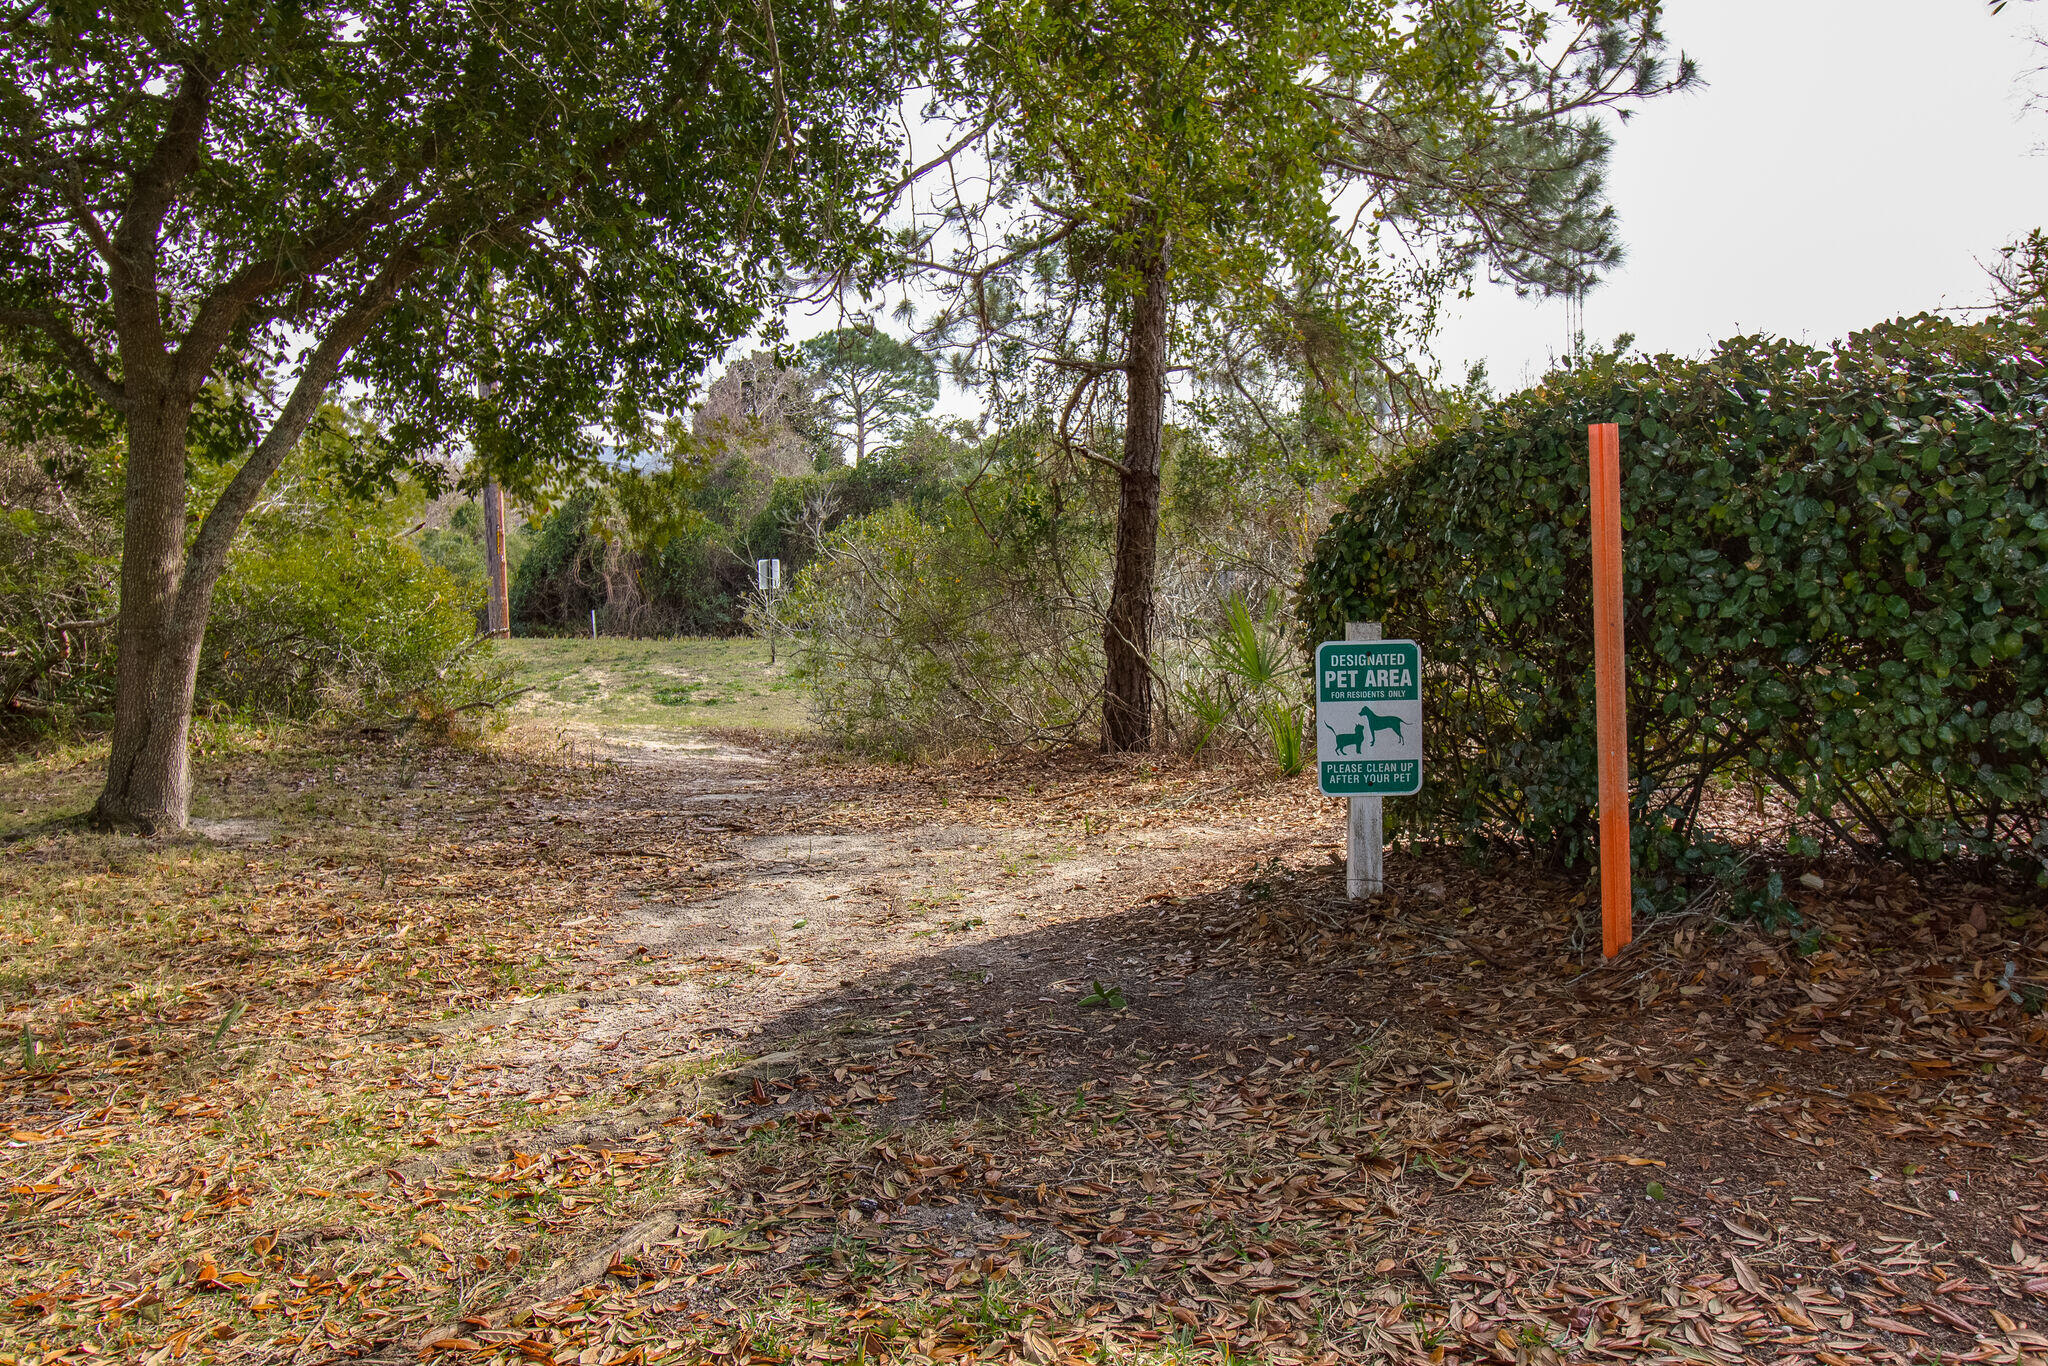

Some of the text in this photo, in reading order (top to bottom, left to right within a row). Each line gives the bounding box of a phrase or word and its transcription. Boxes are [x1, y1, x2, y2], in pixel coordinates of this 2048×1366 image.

[1331, 653, 1405, 667] DESIGNATED
[1324, 669, 1412, 688] PET AREA
[1331, 690, 1406, 699] FOR RESIDENTS ONLY
[1327, 762, 1414, 773] PLEASE CLEAN UP
[1329, 773, 1411, 784] AFTER YOUR PET
